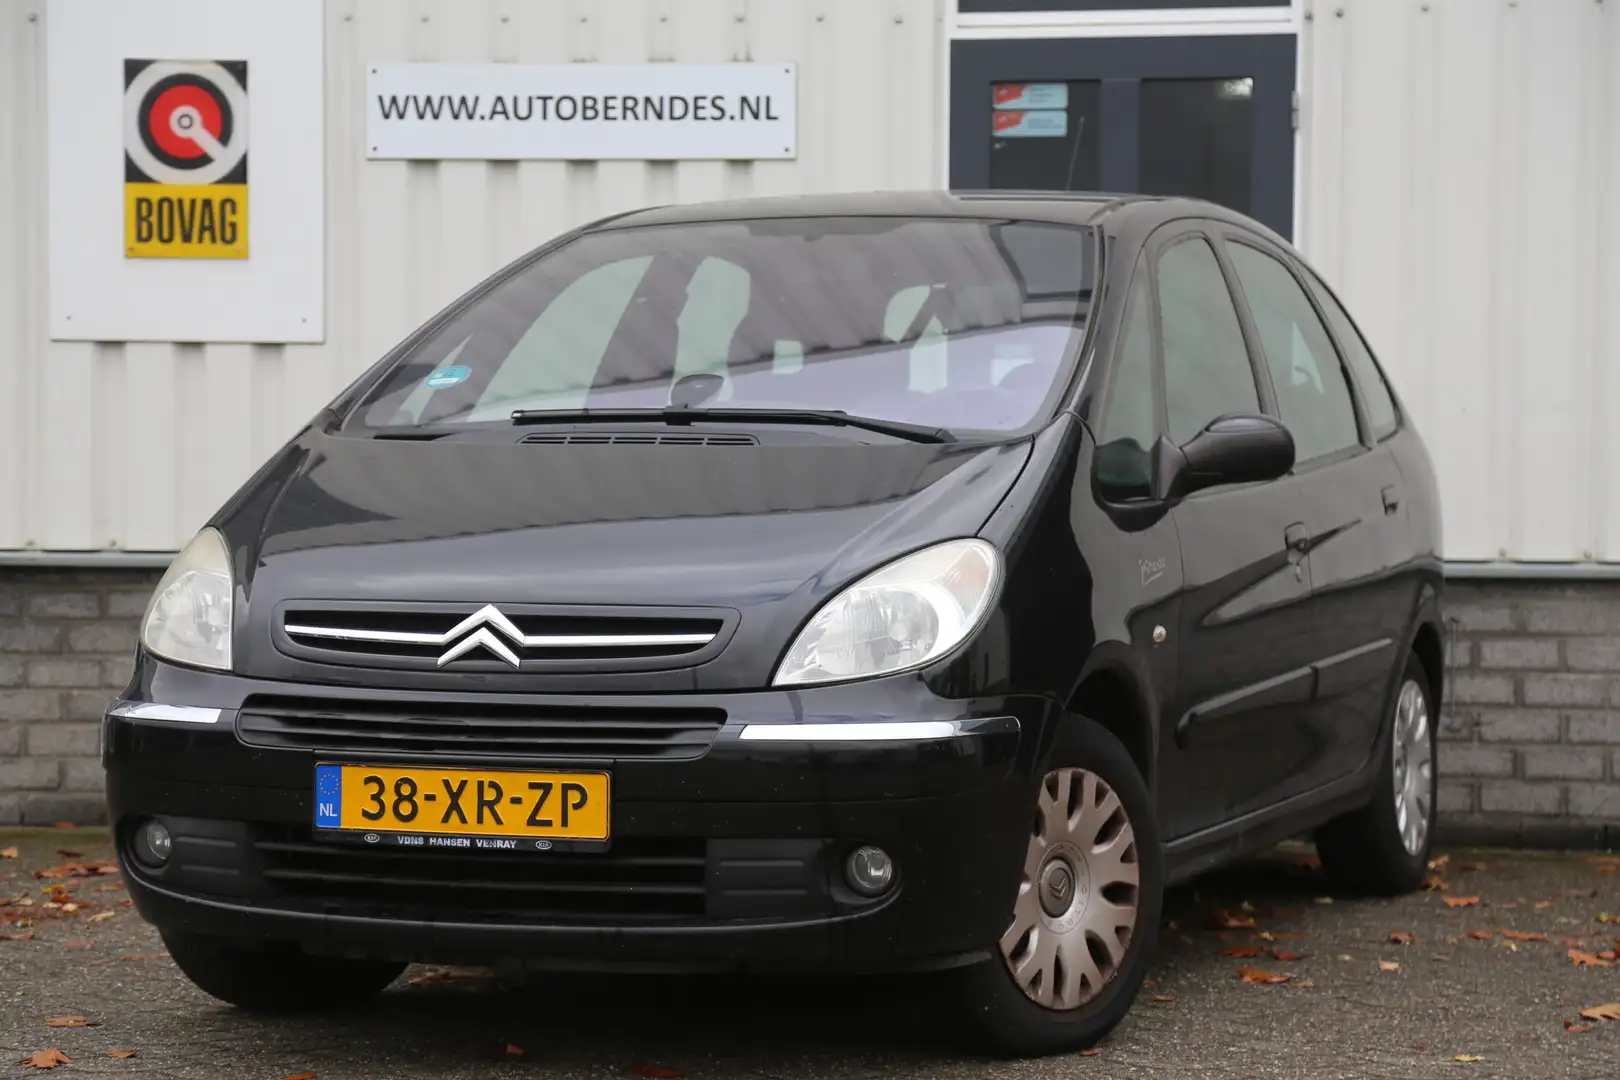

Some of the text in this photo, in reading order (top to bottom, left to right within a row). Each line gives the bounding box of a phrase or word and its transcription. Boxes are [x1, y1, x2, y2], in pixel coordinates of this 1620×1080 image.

[378, 94, 779, 121] WWW.AUTOBERNDES.NL
[136, 196, 237, 245] BOVAG
[319, 803, 338, 817] NL
[361, 775, 588, 828] 38-XR-ZP
[429, 837, 471, 847] HANSEN
[475, 838, 518, 849] VENRAY
